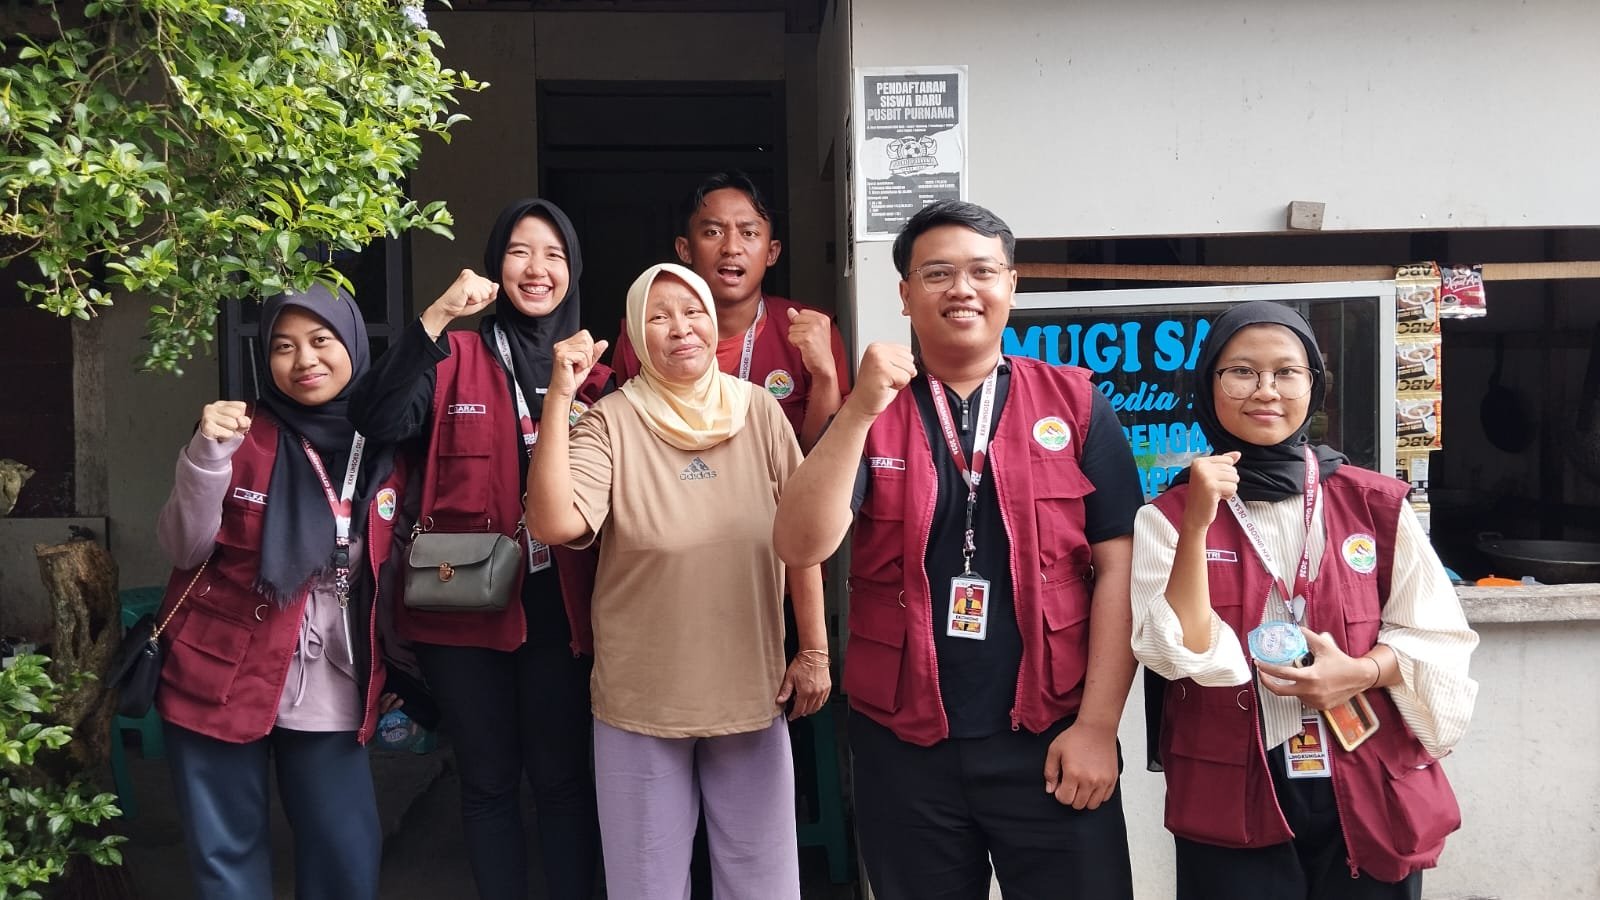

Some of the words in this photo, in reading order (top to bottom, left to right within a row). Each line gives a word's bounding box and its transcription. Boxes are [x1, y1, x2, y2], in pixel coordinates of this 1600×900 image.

[876, 81, 946, 95] PENDAFTARAN
[880, 95, 913, 108] SISWA
[915, 94, 942, 106] BARU
[867, 108, 902, 121] PUSBIT
[904, 106, 955, 120] PURNAMA
[1398, 264, 1433, 277] ABC
[1398, 322, 1435, 334] ABC
[1002, 322, 1142, 373] MUGI
[1397, 379, 1435, 391] ABC
[1121, 421, 1208, 456] ENGA
[1397, 436, 1435, 448] ABC
[680, 471, 717, 480] adidas
[1306, 488, 1315, 506] DESA
[1232, 502, 1248, 520] DESA
[1245, 522, 1266, 549] UNSOED
